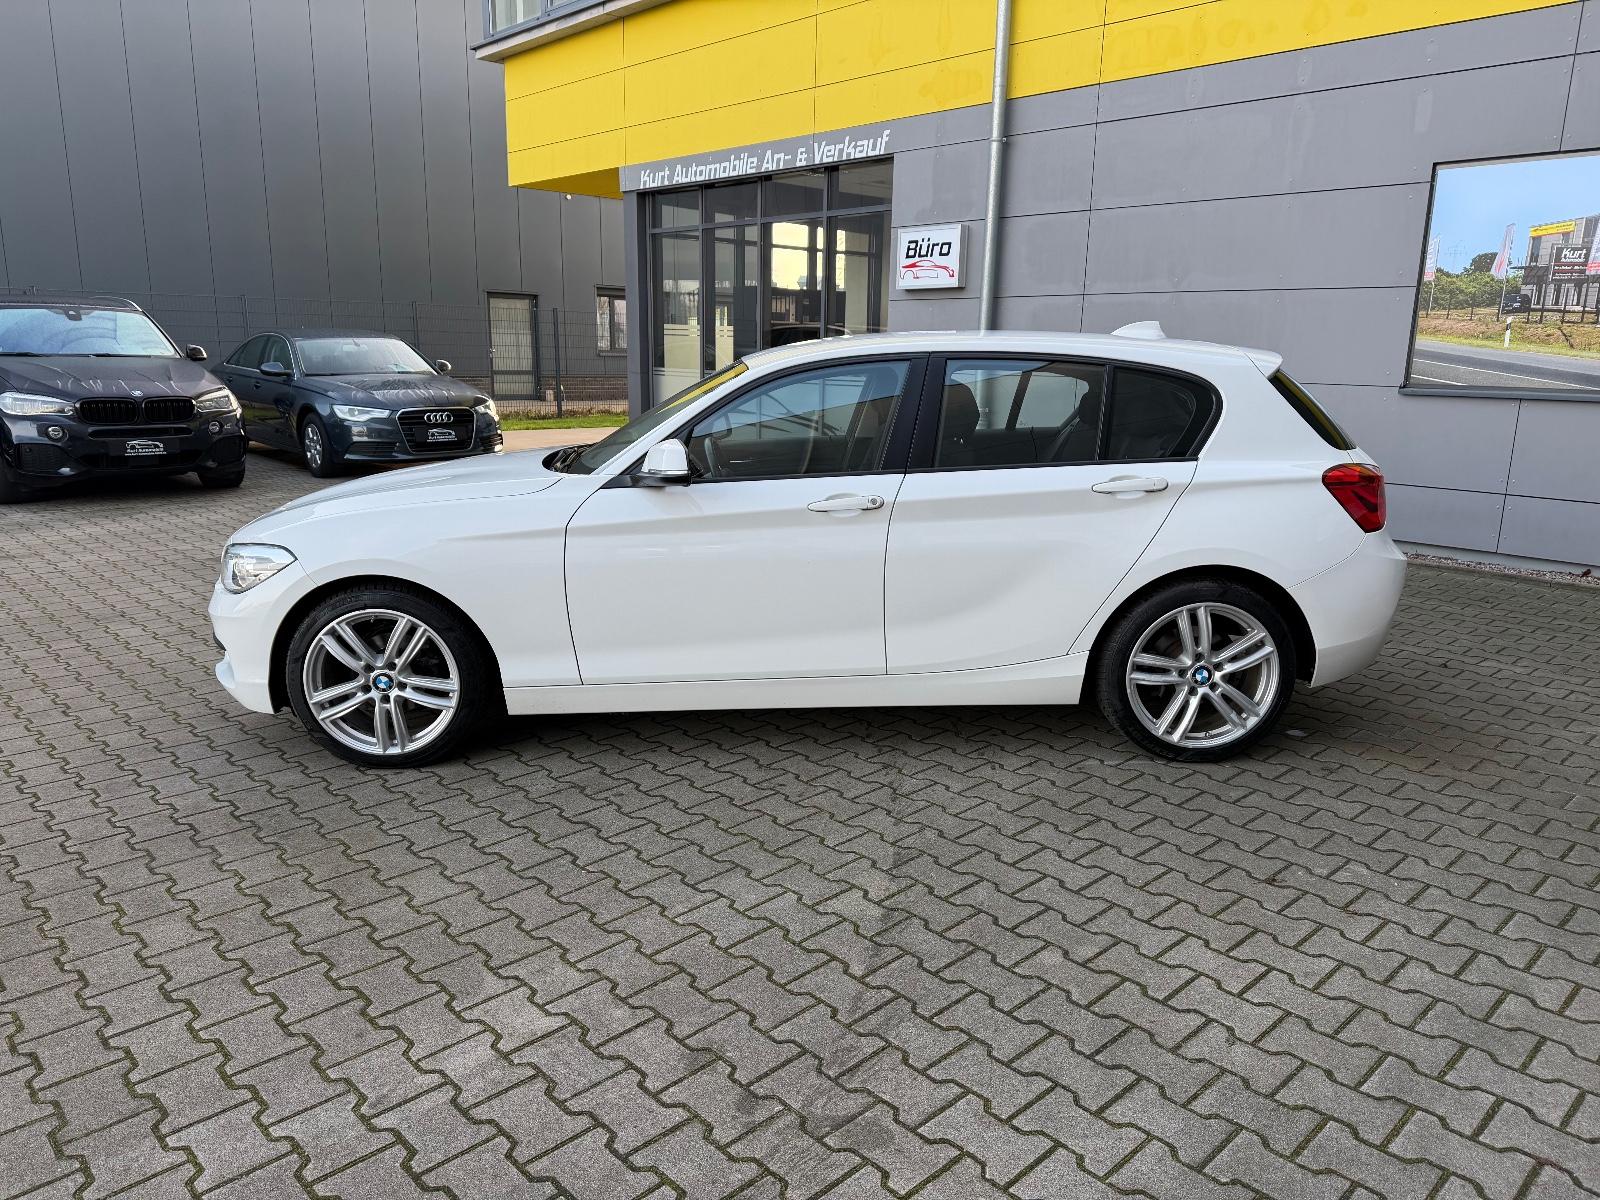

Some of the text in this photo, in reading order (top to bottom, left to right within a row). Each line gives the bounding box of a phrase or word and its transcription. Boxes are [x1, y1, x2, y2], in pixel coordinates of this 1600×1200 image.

[640, 129, 891, 189] Kurt Automobile An- & Verkauf
[905, 237, 952, 259] Büro
[1561, 247, 1587, 258] Kurt
